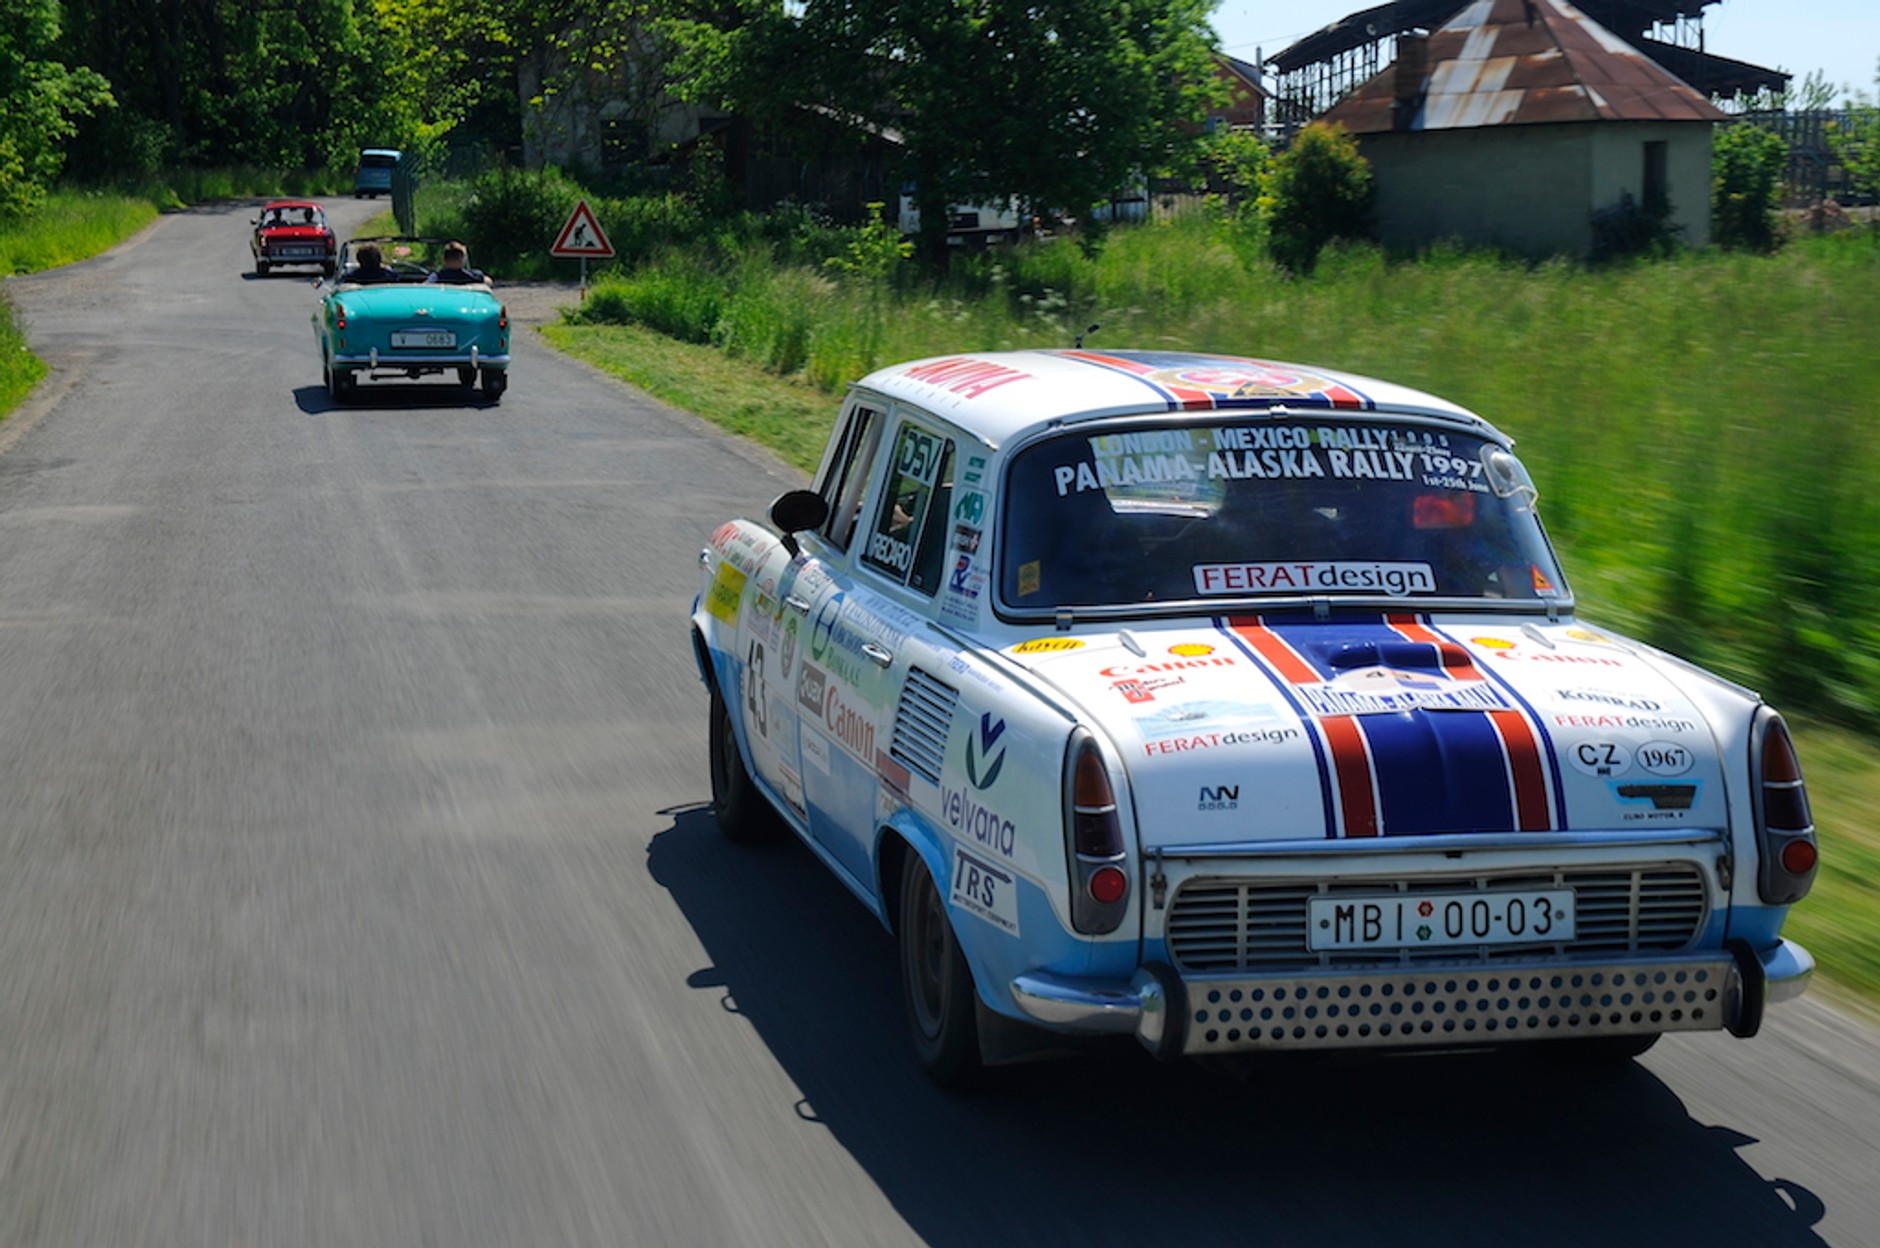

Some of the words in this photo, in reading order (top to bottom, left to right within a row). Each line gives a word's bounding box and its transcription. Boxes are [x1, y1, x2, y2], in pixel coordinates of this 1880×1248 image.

[1090, 430, 1193, 458] LONDON
[1211, 427, 1310, 450] MEXICO
[1317, 427, 1389, 450] RALLY
[1328, 450, 1414, 479] RALLY
[1420, 454, 1483, 478] 1997
[1202, 565, 1427, 594] FERATdesign
[1099, 656, 1235, 678] Canon
[1495, 651, 1623, 667] Canon
[1557, 689, 1661, 711] KONRAD
[826, 685, 875, 763] Canon
[1555, 715, 1695, 733] FERATdesign
[1145, 728, 1298, 756] FERATdesign
[1578, 744, 1621, 766] CZ
[1643, 749, 1684, 767] 1967
[941, 785, 1015, 857] velvana
[954, 850, 1012, 908] TRS
[1445, 898, 1552, 938] 00-03
